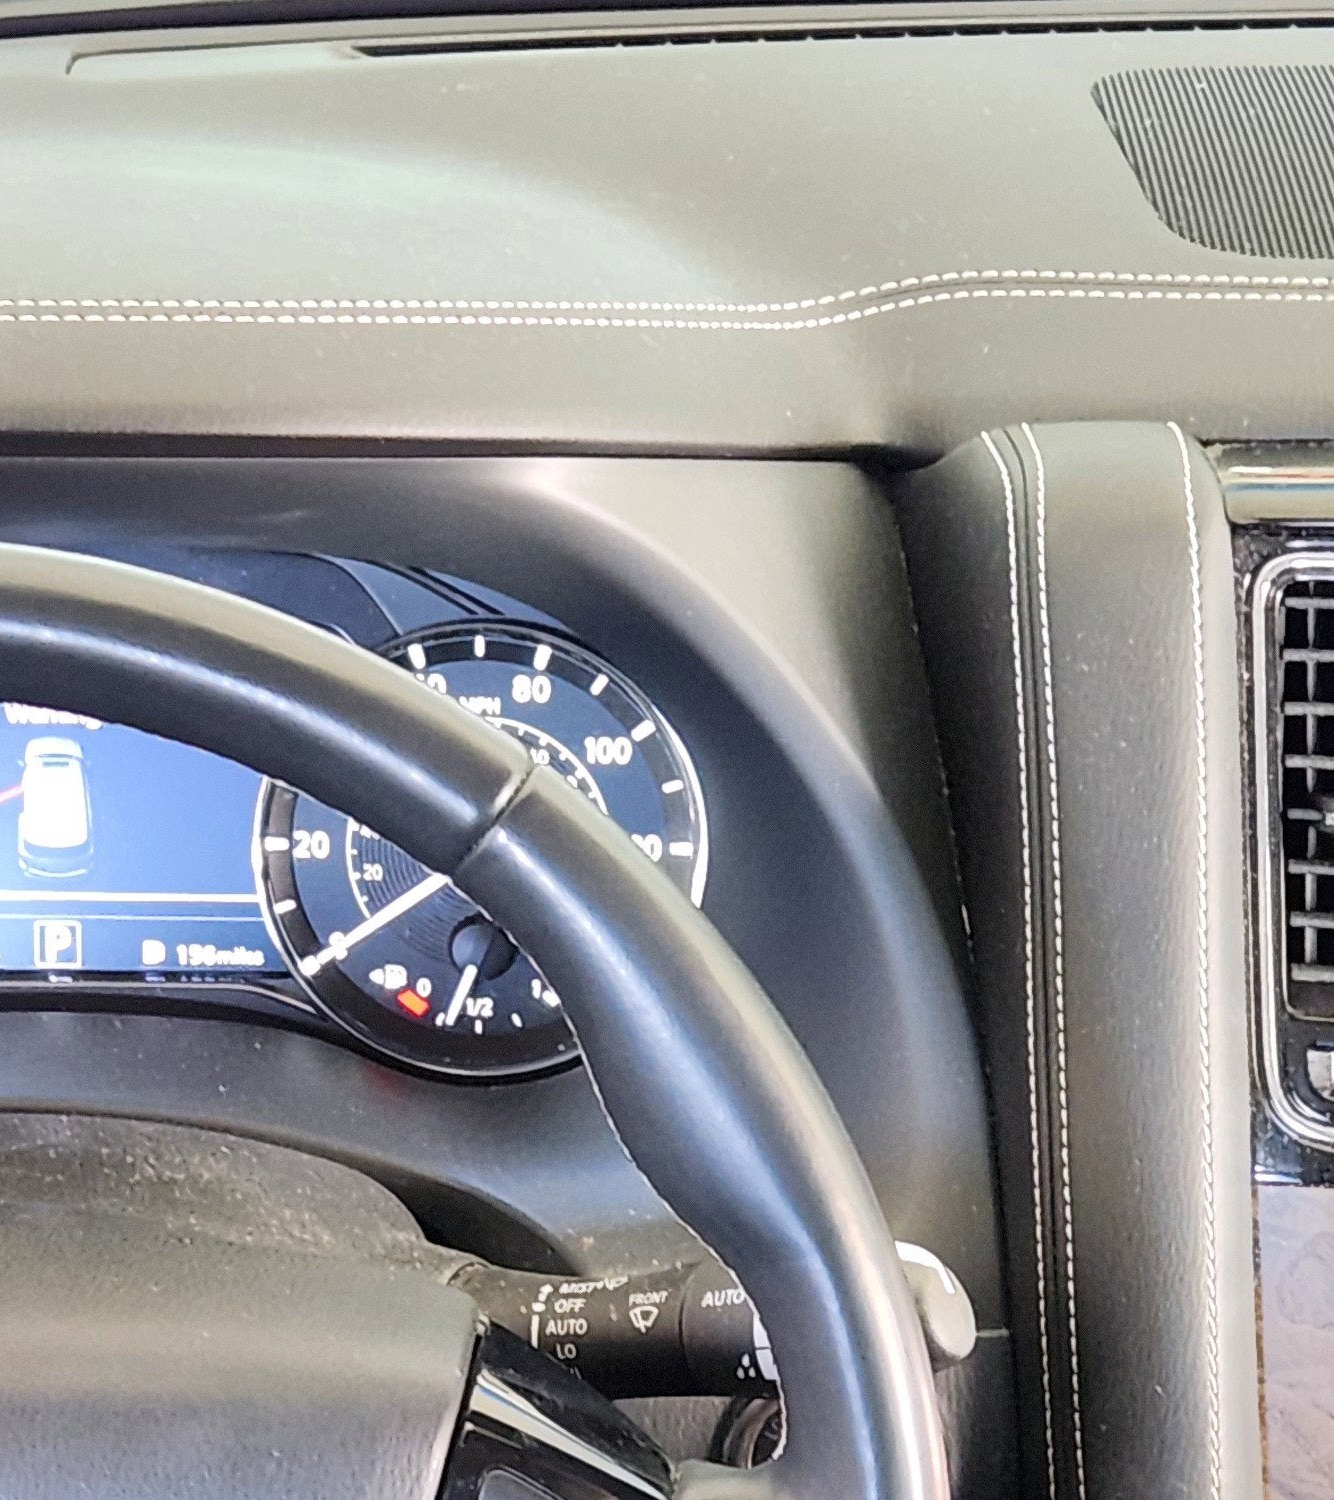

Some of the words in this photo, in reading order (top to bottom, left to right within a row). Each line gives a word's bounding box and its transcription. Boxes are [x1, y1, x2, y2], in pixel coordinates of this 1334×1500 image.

[511, 674, 552, 704] 80
[583, 736, 633, 766] 100
[292, 829, 330, 859] 20
[362, 862, 384, 881] 20
[45, 925, 72, 964] P
[416, 977, 432, 998] 0
[531, 978, 542, 999] 1
[466, 996, 495, 1017] 1/2
[554, 1297, 586, 1314] OFF
[628, 1290, 669, 1306] FRONT
[700, 1289, 745, 1308] AUTO
[544, 1318, 588, 1336] AUTO
[555, 1344, 577, 1360] LO
